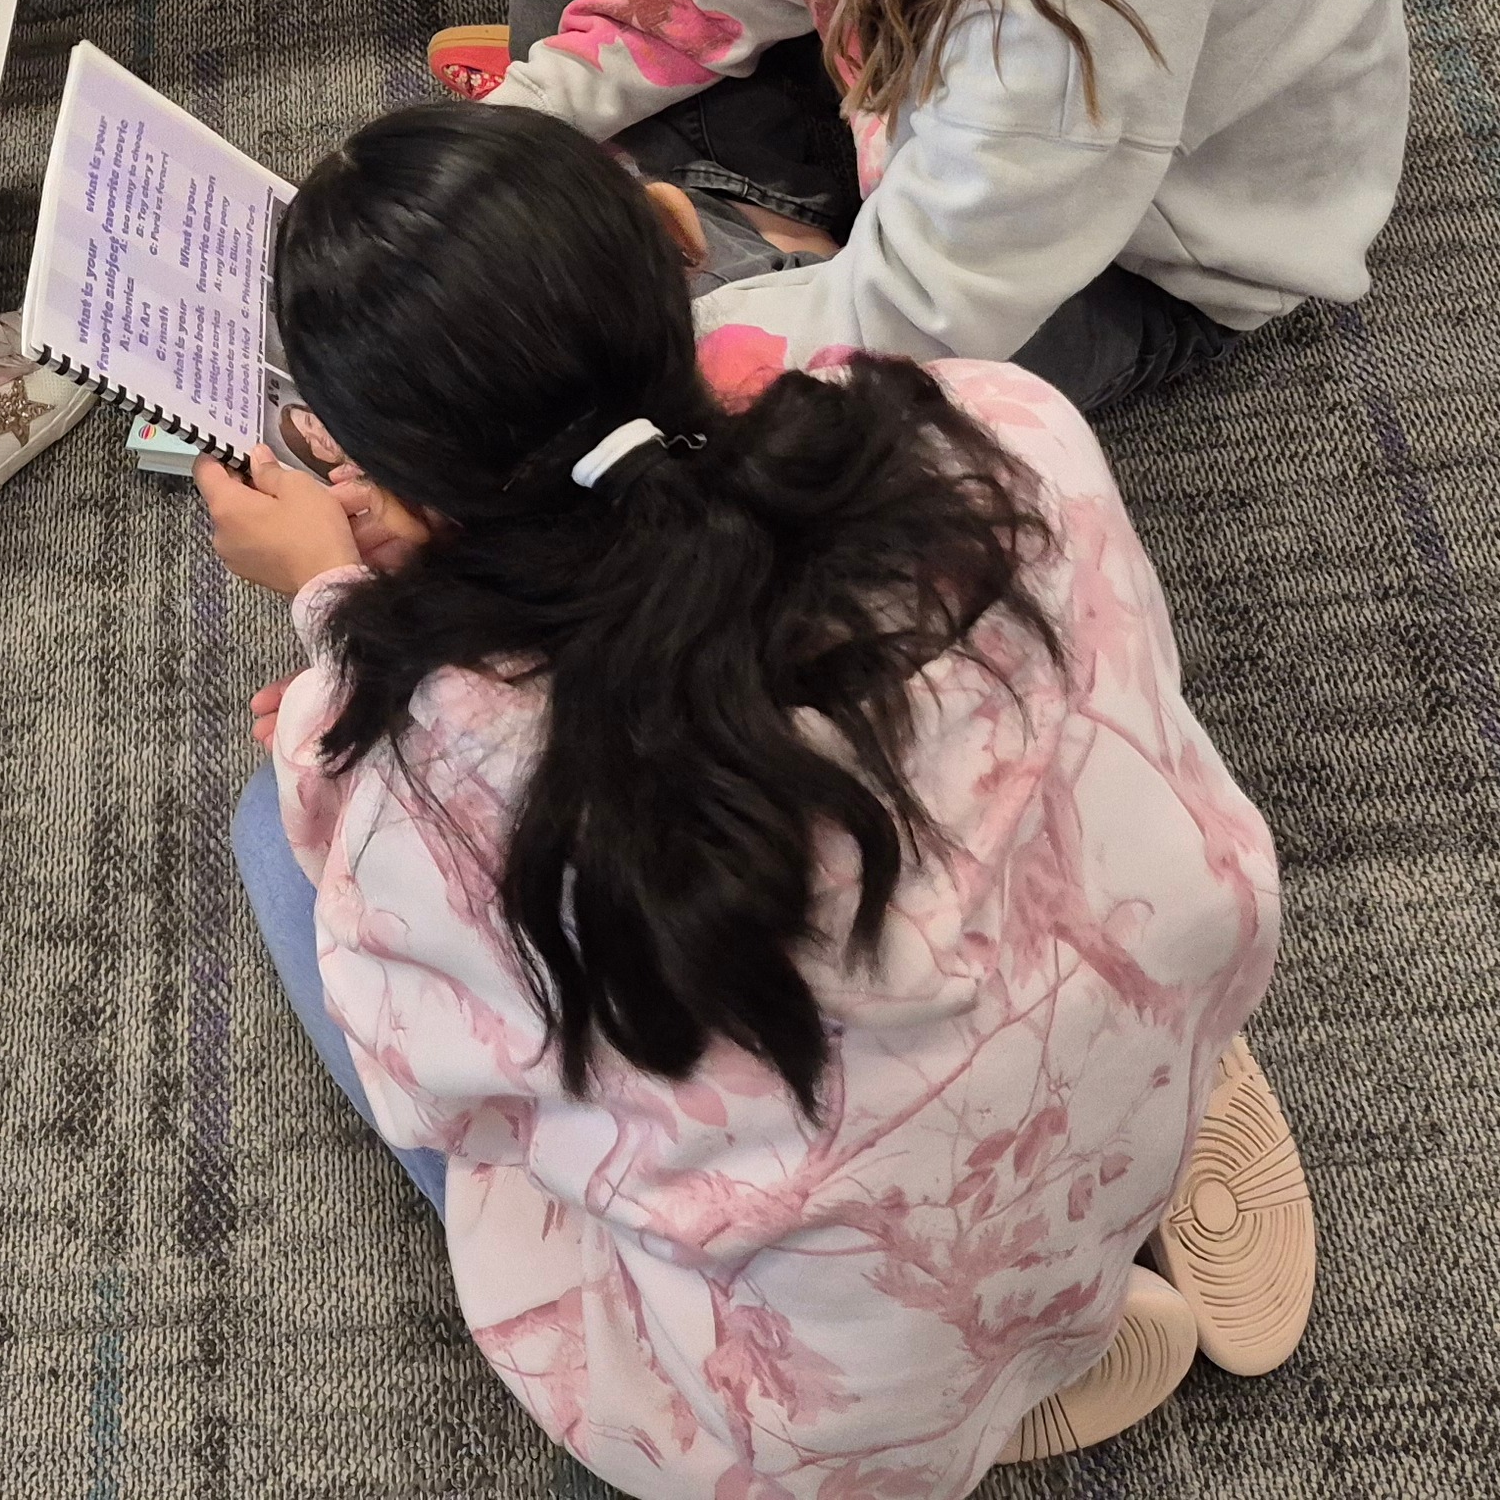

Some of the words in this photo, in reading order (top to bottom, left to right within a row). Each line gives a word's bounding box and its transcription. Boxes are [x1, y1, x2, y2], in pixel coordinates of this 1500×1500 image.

[95, 115, 108, 156] your
[131, 120, 145, 162] choose
[89, 154, 102, 170] is
[129, 164, 137, 177] to
[145, 152, 154, 163] 3
[102, 168, 120, 234] favorite
[113, 119, 129, 169] movie
[141, 164, 154, 199] story
[85, 172, 99, 213] what
[125, 178, 137, 214] many
[156, 196, 163, 211] vs
[187, 177, 197, 216] your
[122, 214, 131, 235] too
[138, 199, 149, 221] Toy
[183, 214, 193, 229] is
[220, 195, 231, 228] pony
[246, 204, 256, 233] Ferb
[136, 223, 145, 238] B:
[151, 210, 161, 242] Ford
[196, 233, 210, 294] favorite
[203, 174, 216, 233] cartoon
[119, 238, 128, 254] A:
[149, 242, 159, 256] C:
[180, 229, 192, 269] What
[216, 227, 226, 257] little
[230, 227, 241, 263] Bluey
[246, 232, 254, 257] and
[86, 238, 98, 282] your
[216, 258, 226, 278] my
[229, 262, 238, 277] B:
[81, 281, 94, 297] is
[214, 278, 223, 292] A:
[242, 257, 252, 305] Phineas
[96, 300, 114, 372] favorite
[105, 235, 121, 300] subject
[121, 276, 135, 335] phonics
[140, 301, 151, 328] Art
[178, 298, 189, 336] your
[241, 305, 250, 319] C:
[78, 298, 92, 344] what
[159, 305, 170, 345] math
[194, 304, 205, 343] book
[211, 309, 221, 350] series
[227, 318, 236, 346] web
[120, 334, 131, 353] A:
[138, 329, 150, 347] B:
[174, 335, 186, 350] is
[241, 326, 252, 360] thief
[156, 344, 167, 362] C:
[173, 350, 185, 391] what
[191, 343, 204, 405] favorite
[209, 351, 221, 402] twilight
[240, 362, 250, 395] book
[208, 403, 218, 420] A:
[224, 412, 233, 428] B:
[240, 396, 249, 419] the
[240, 420, 249, 436] C:
